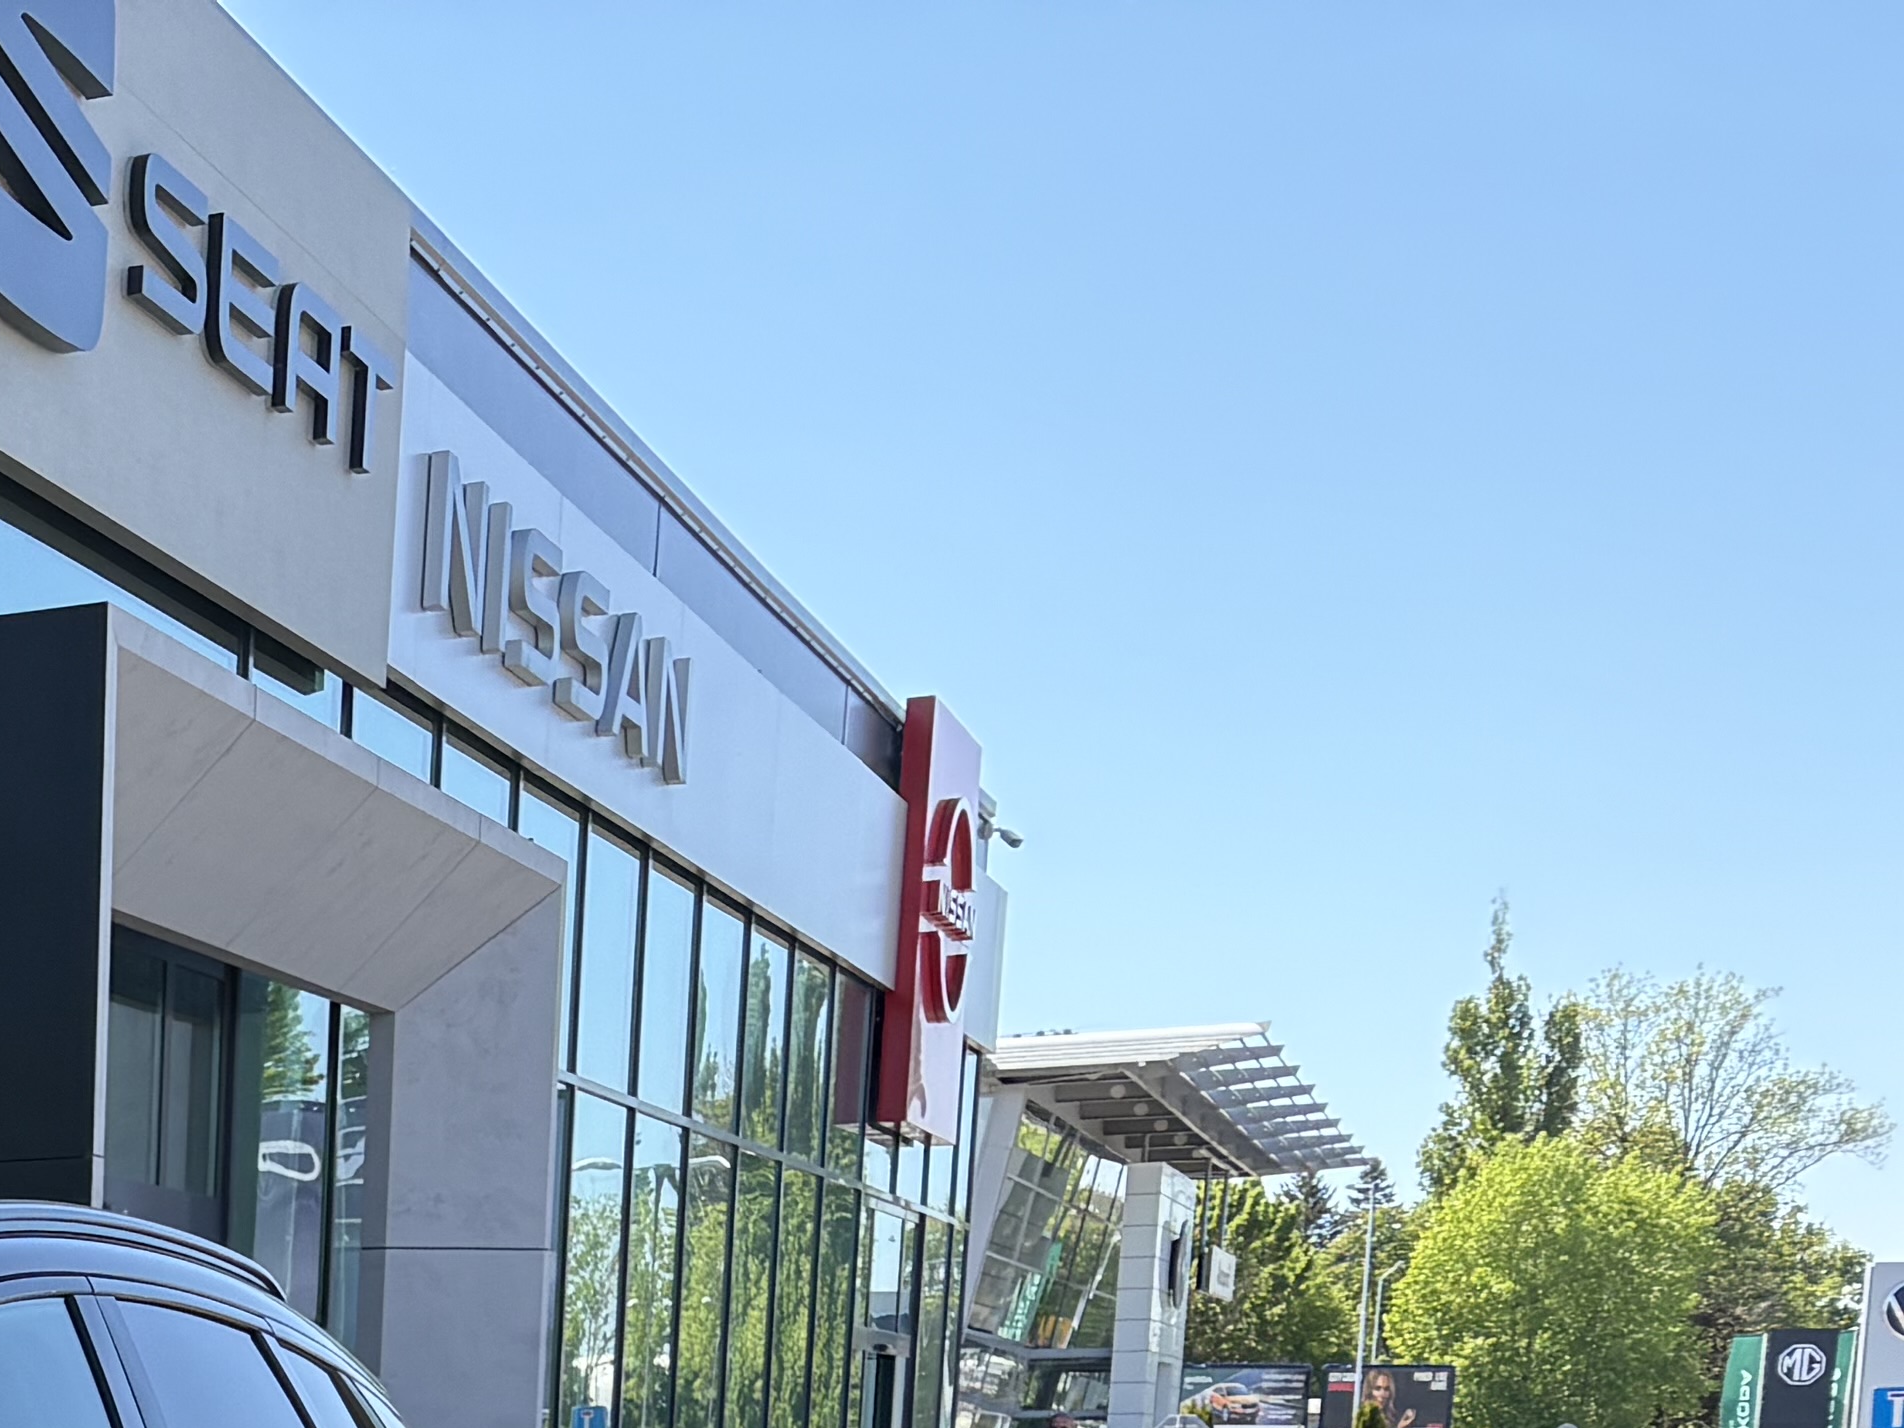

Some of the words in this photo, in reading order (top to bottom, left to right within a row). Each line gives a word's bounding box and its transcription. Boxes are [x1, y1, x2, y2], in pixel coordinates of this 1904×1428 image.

[128, 152, 393, 475] SEAT
[422, 450, 693, 785] NISSAN
[1782, 1348, 1821, 1382] MG
